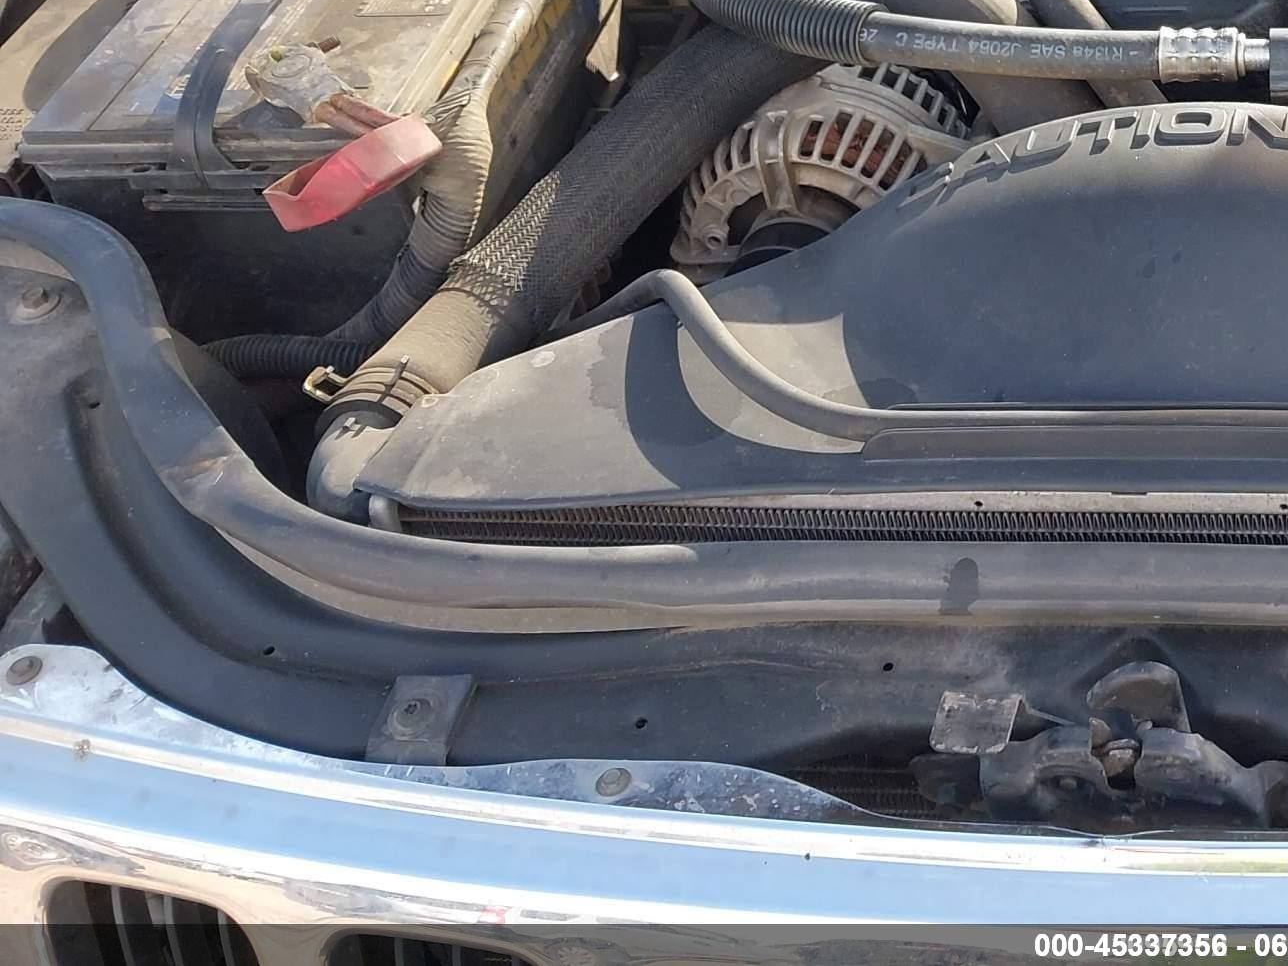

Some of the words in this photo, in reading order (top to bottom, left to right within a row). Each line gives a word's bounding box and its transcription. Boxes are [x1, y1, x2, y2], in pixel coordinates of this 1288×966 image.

[895, 32, 907, 47] C
[912, 32, 959, 52] TYPE
[967, 41, 1022, 59] J2064
[1029, 44, 1067, 59] SAE
